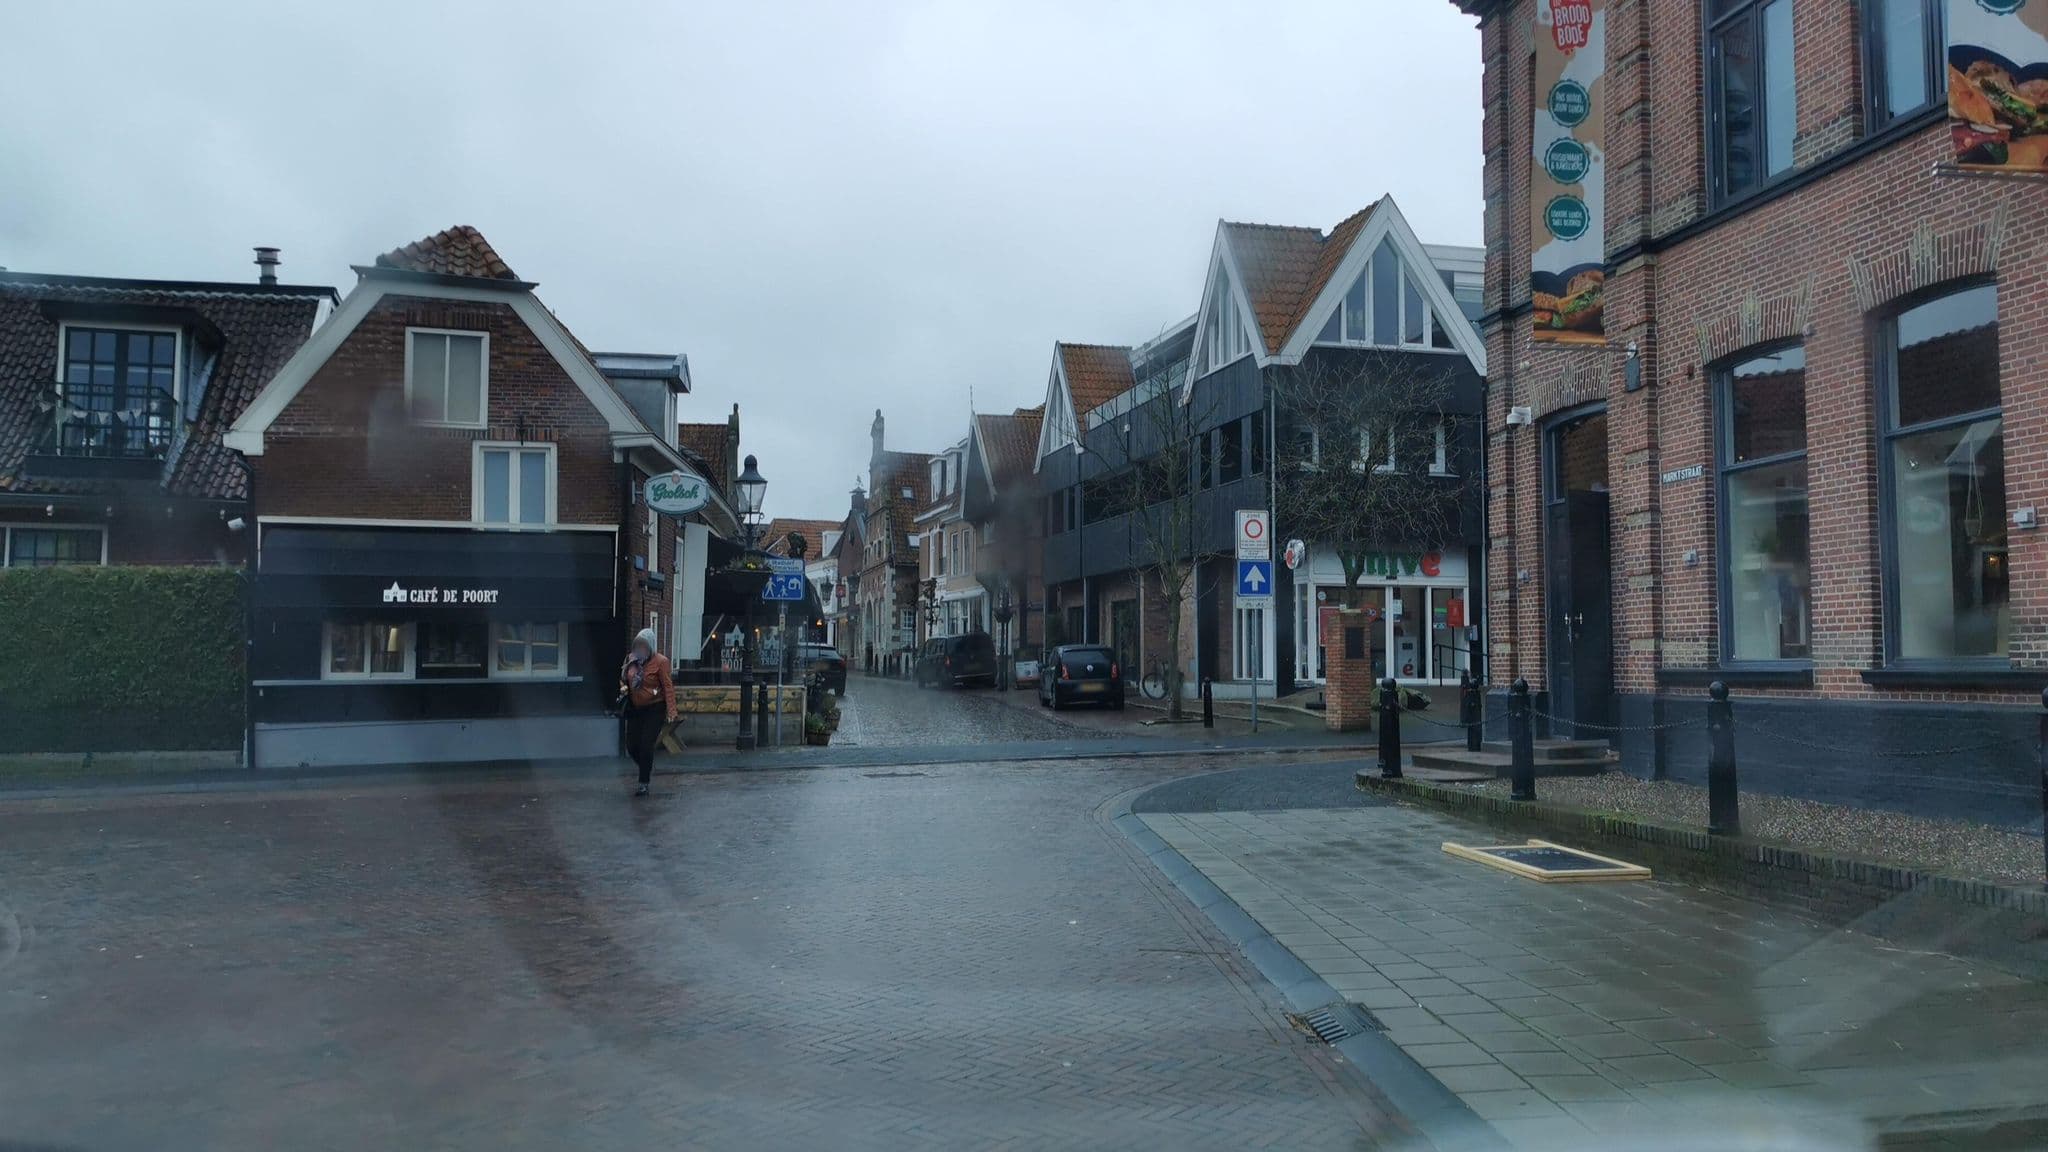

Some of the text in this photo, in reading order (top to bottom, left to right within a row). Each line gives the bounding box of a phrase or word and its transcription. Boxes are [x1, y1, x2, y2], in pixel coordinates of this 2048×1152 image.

[1554, 4, 1590, 26] BROOD
[1557, 25, 1584, 46] BODE
[652, 483, 699, 501] Grolsch
[410, 586, 499, 603] CAFÉ DE POORT
